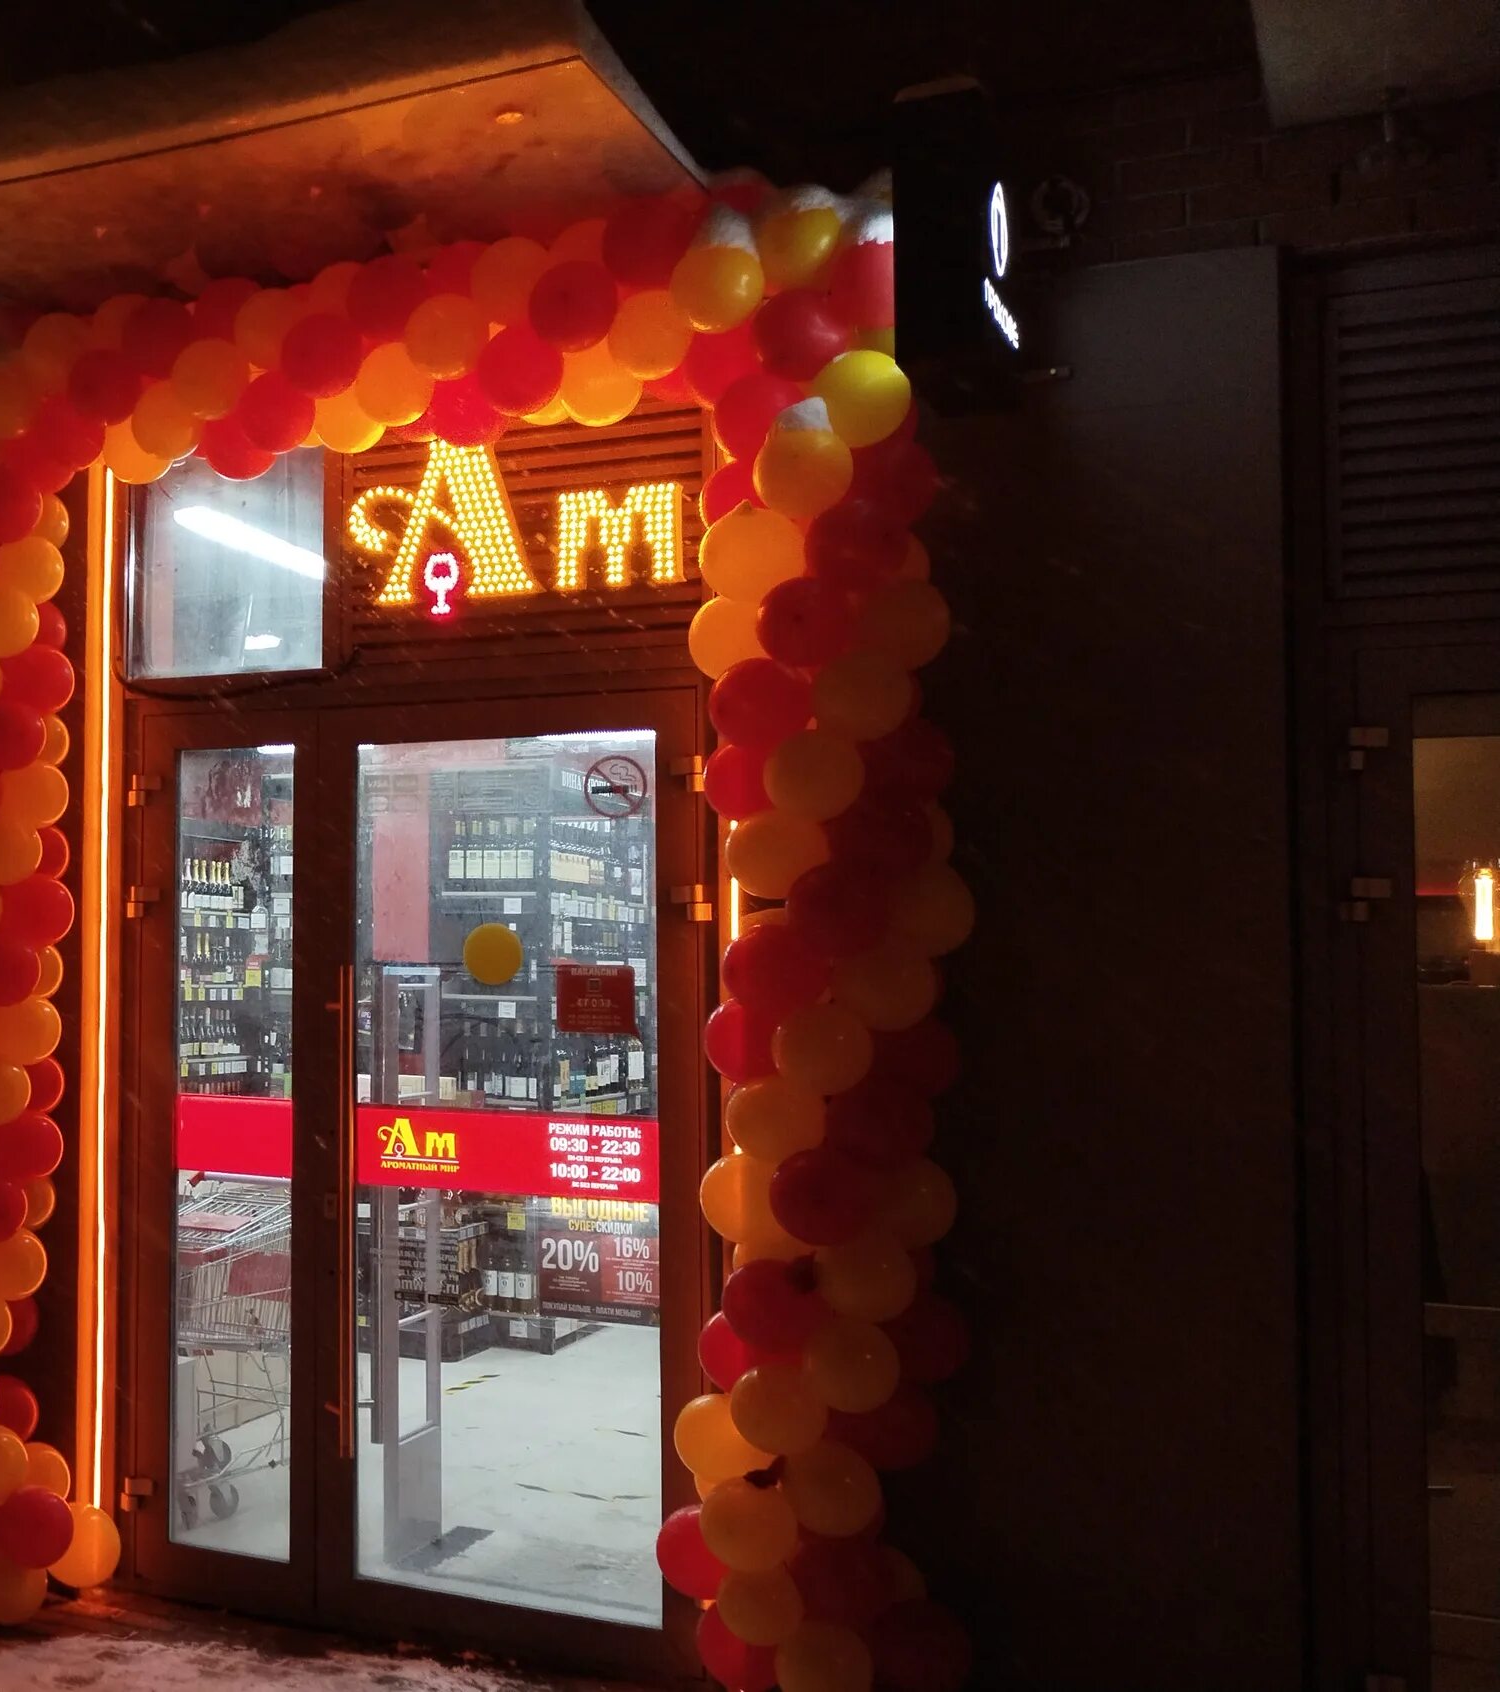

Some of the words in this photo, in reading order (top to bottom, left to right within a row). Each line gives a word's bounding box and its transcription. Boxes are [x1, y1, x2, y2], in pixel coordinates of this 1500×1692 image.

[548, 1122, 590, 1136] РЕЖИМ
[591, 1125, 642, 1139] РАБОТЫ:
[549, 1137, 589, 1153] 09:30
[600, 1140, 641, 1156] 22:30
[380, 1160, 438, 1172] АРОМАТНЫЙ
[439, 1164, 460, 1173] МИР
[549, 1162, 589, 1179] 10:00
[600, 1166, 641, 1183] 22:00
[550, 1196, 650, 1222] ВЫГОДНЫЕ
[568, 1220, 634, 1234] СУПЕРСКИДКИ
[541, 1237, 599, 1273] 20%
[613, 1236, 650, 1259] 16%
[616, 1270, 652, 1294] 10%
